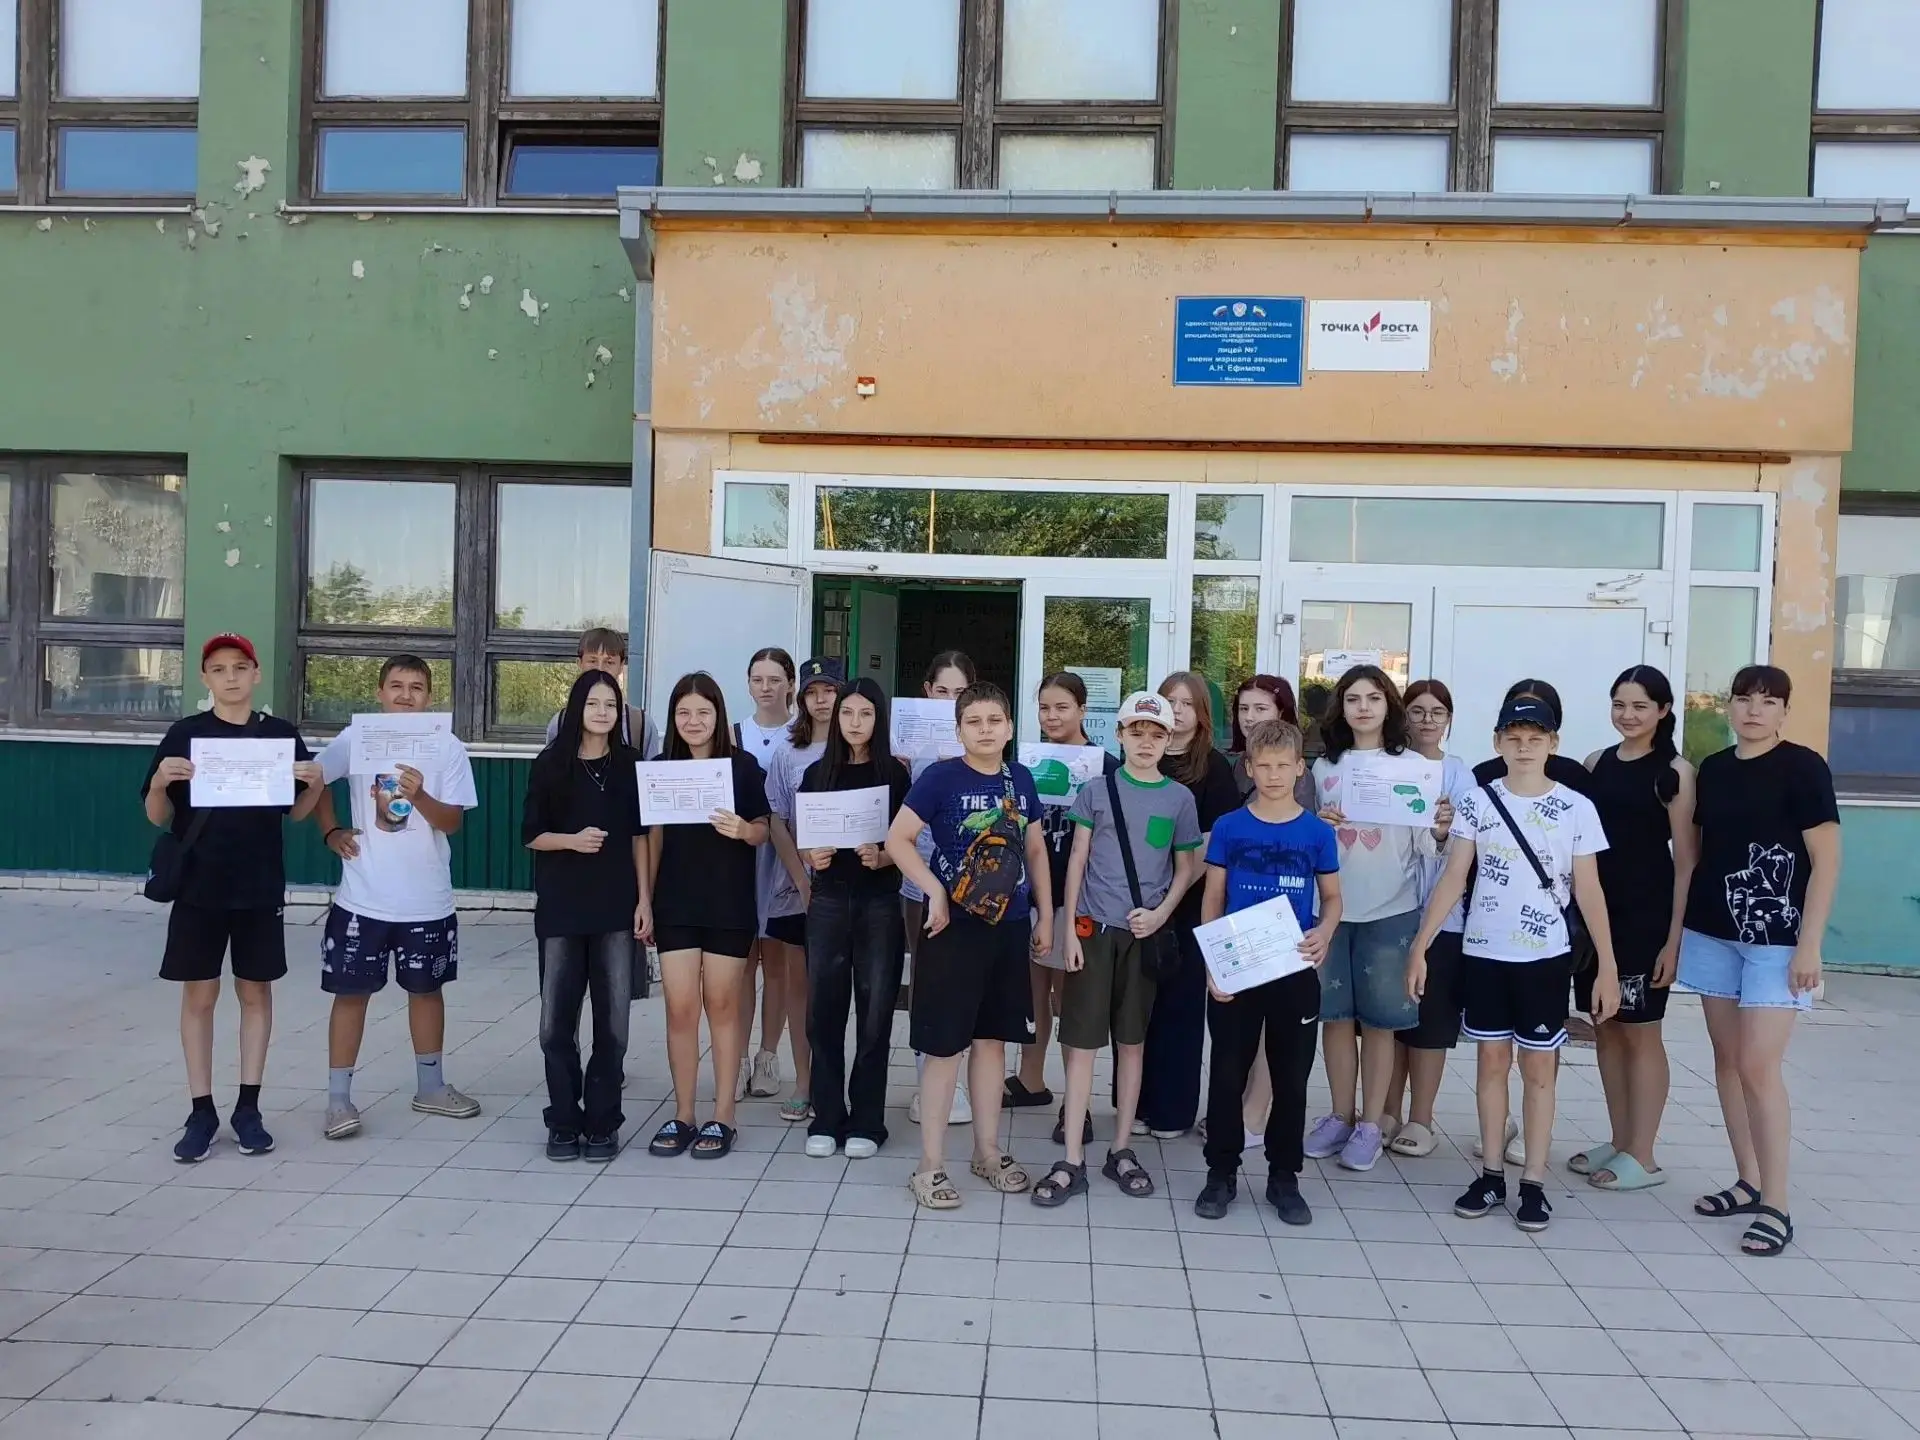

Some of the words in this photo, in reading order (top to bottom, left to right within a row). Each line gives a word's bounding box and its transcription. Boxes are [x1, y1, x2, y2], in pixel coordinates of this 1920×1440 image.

[1320, 323, 1360, 332] ТОЧКА
[1380, 324, 1419, 332] РОСТА
[1217, 346, 1242, 354] лицей
[1215, 356, 1252, 364] маршала
[1227, 364, 1266, 373] Ефимова
[960, 794, 989, 810] THE
[995, 794, 1027, 810] WD
[1533, 801, 1559, 821] THE
[1278, 875, 1306, 889] MIAMI
[1520, 920, 1548, 938] THE
